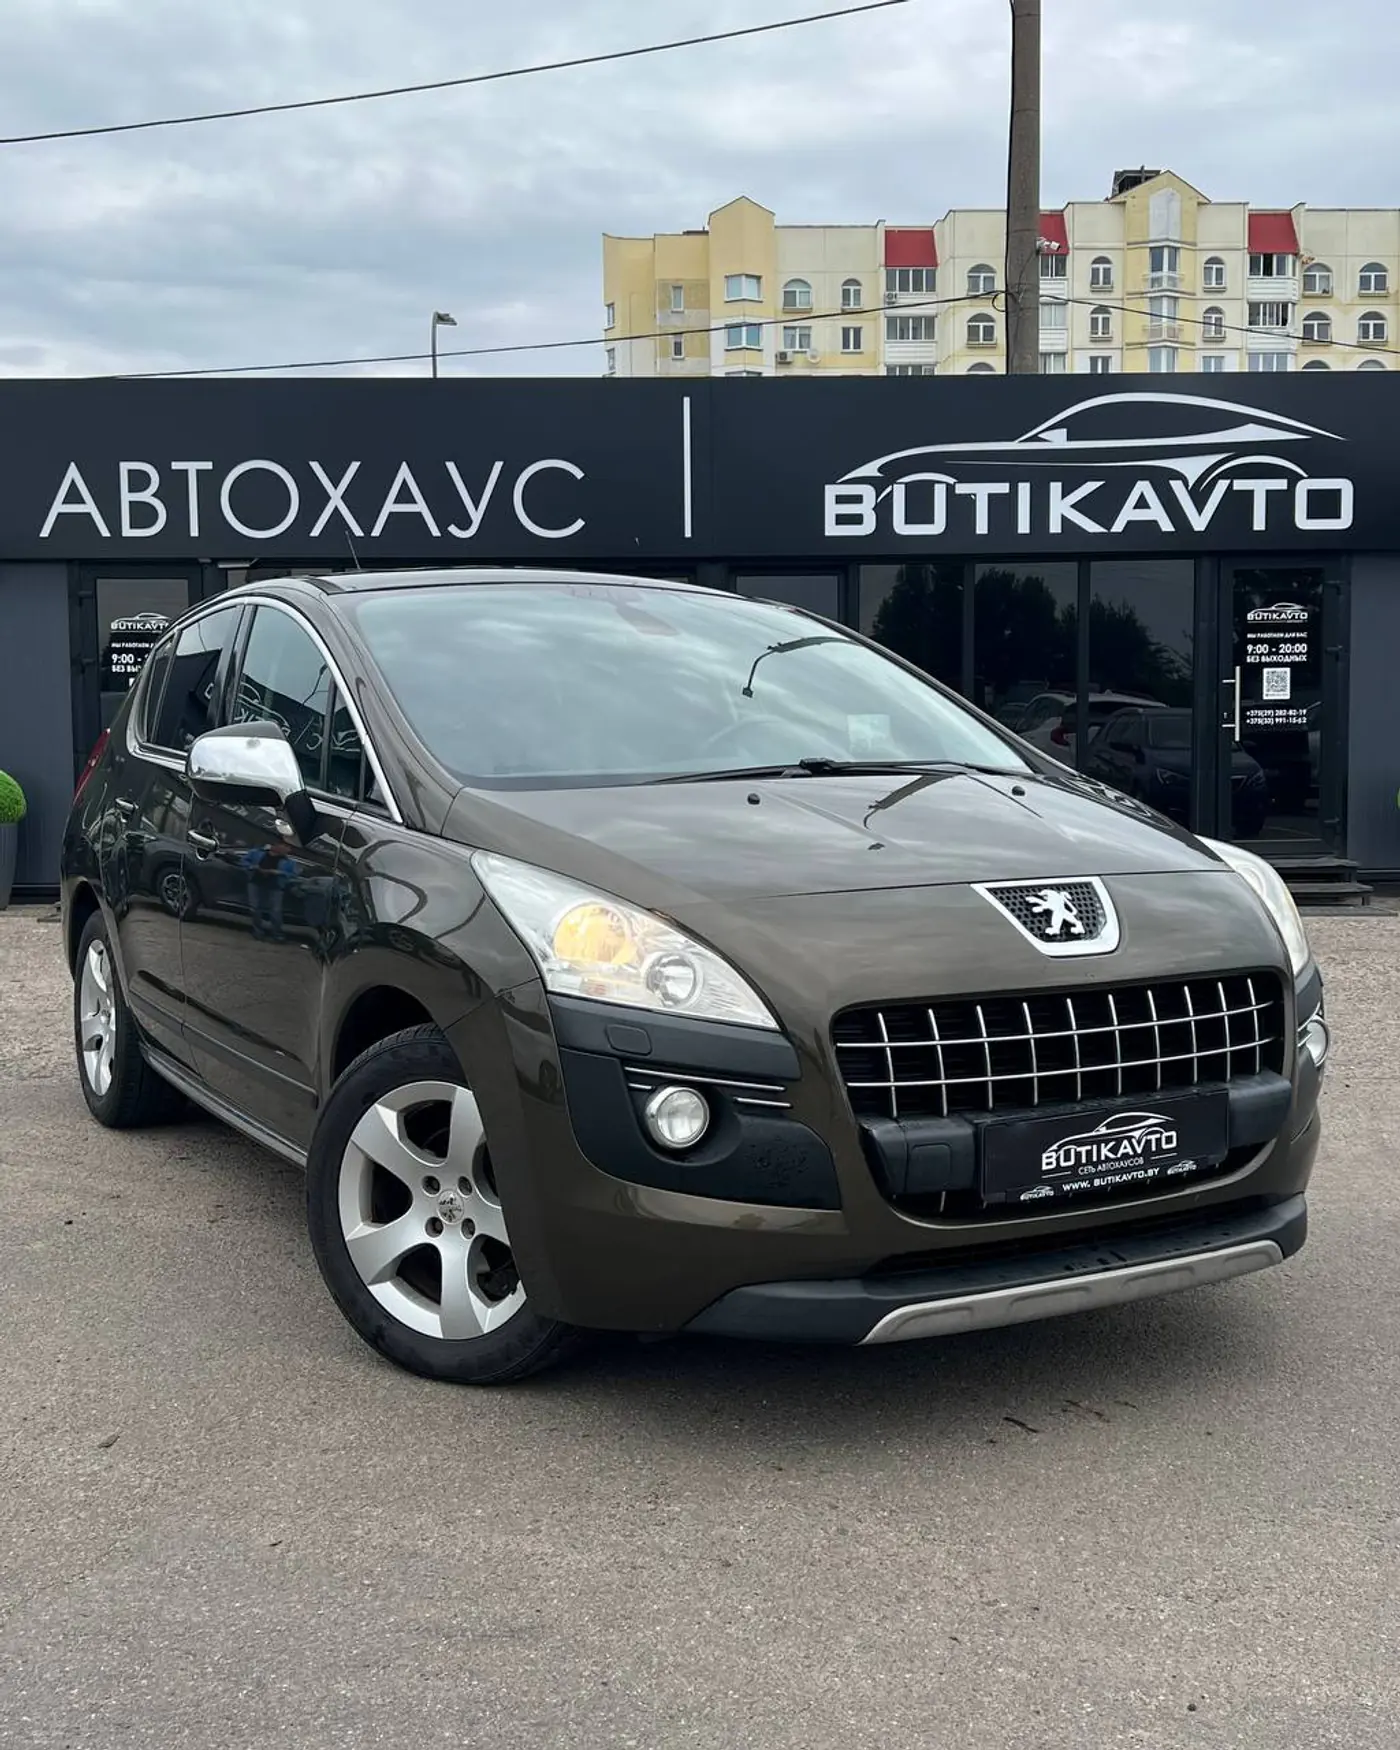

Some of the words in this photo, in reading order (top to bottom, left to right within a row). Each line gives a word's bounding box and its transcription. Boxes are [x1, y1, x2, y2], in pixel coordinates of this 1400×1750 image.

[39, 458, 586, 538] АВТОХАУС
[824, 476, 1355, 537] BUTIKAVTO
[1247, 611, 1308, 620] BUTIKAVTO
[1247, 644, 1269, 654] 9:00
[1278, 643, 1307, 653] 20:00
[1261, 654, 1307, 662] ВЫХОДНЫХ
[112, 653, 134, 664] 9:00
[1041, 1131, 1177, 1171] BUTIKAVTO
[1078, 1165, 1096, 1175] СЕТЬ
[1097, 1156, 1144, 1172] АВТОХАУСОВ
[1062, 1180, 1091, 1192] WWW.
[1093, 1167, 1161, 1187] BUTIKAVTO.BY
